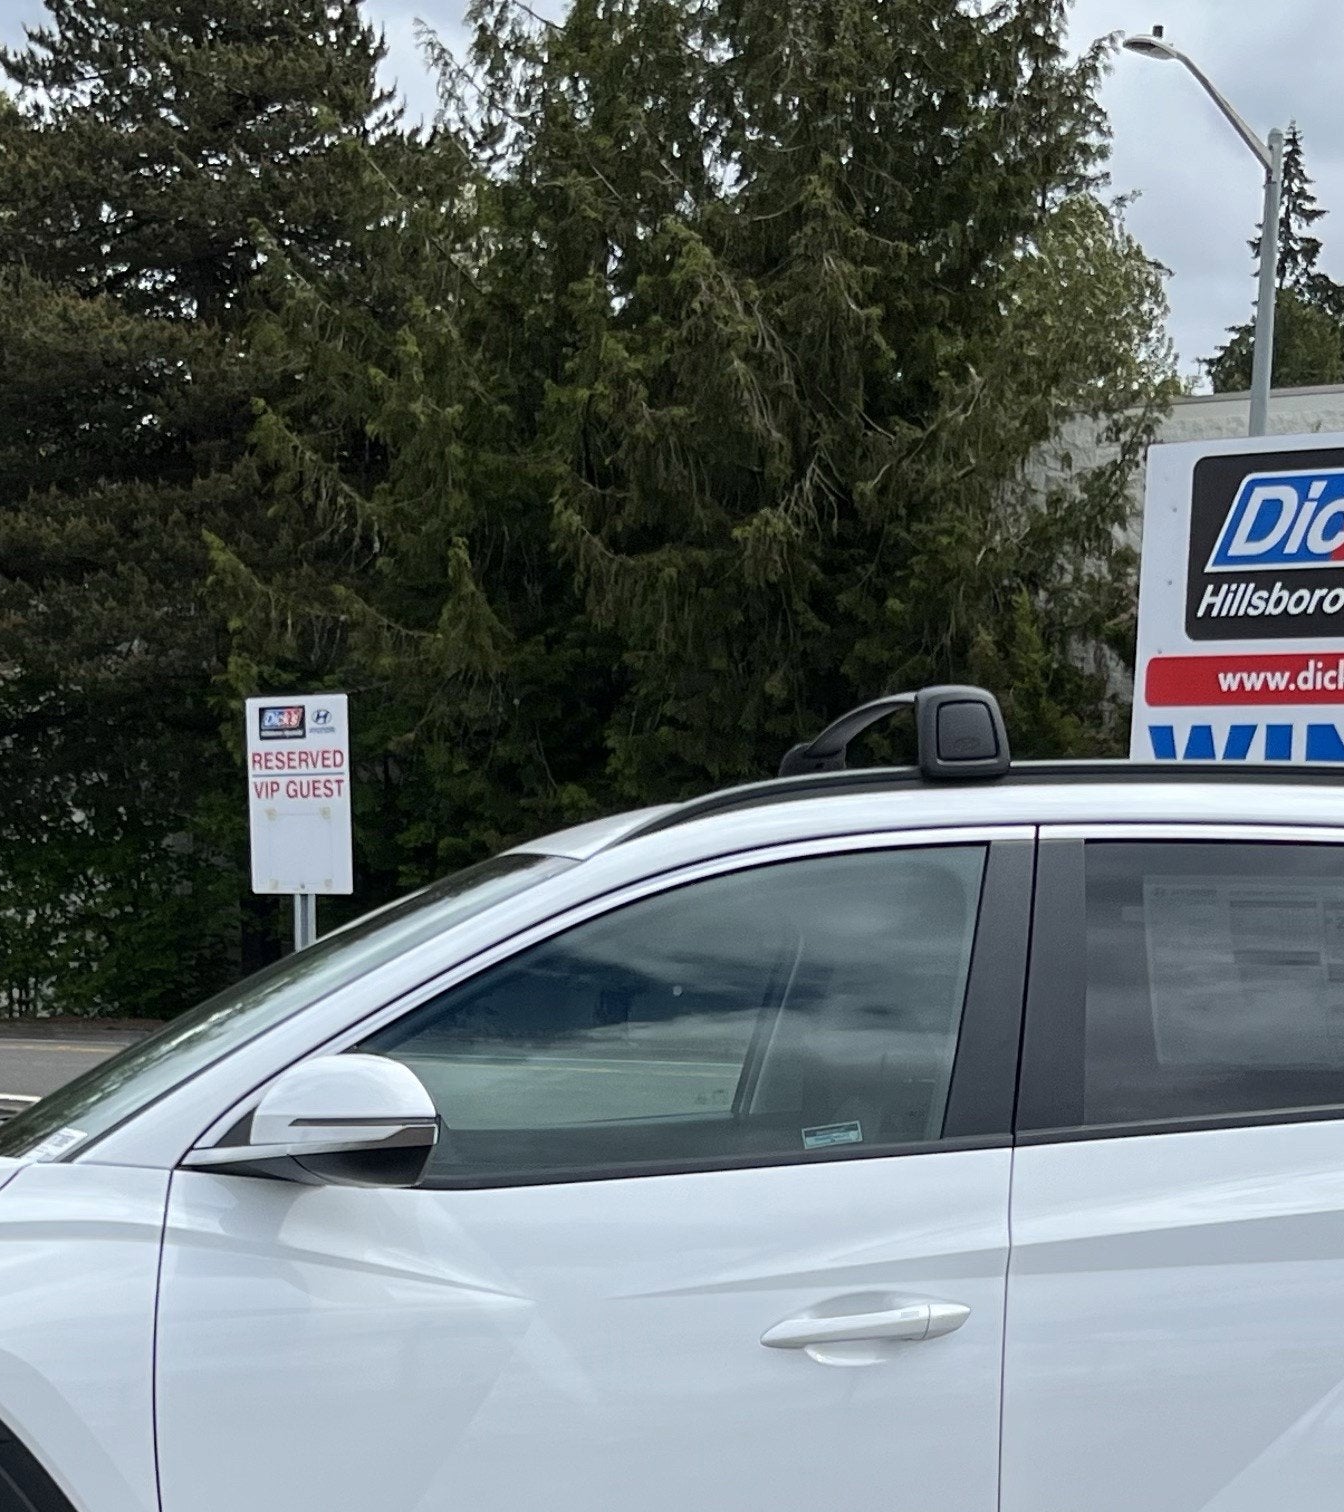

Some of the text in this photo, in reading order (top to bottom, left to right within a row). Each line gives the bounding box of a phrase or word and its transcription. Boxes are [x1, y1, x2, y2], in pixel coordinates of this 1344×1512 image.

[251, 749, 345, 771] RESERVED
[253, 778, 345, 799] VIP GUEST
